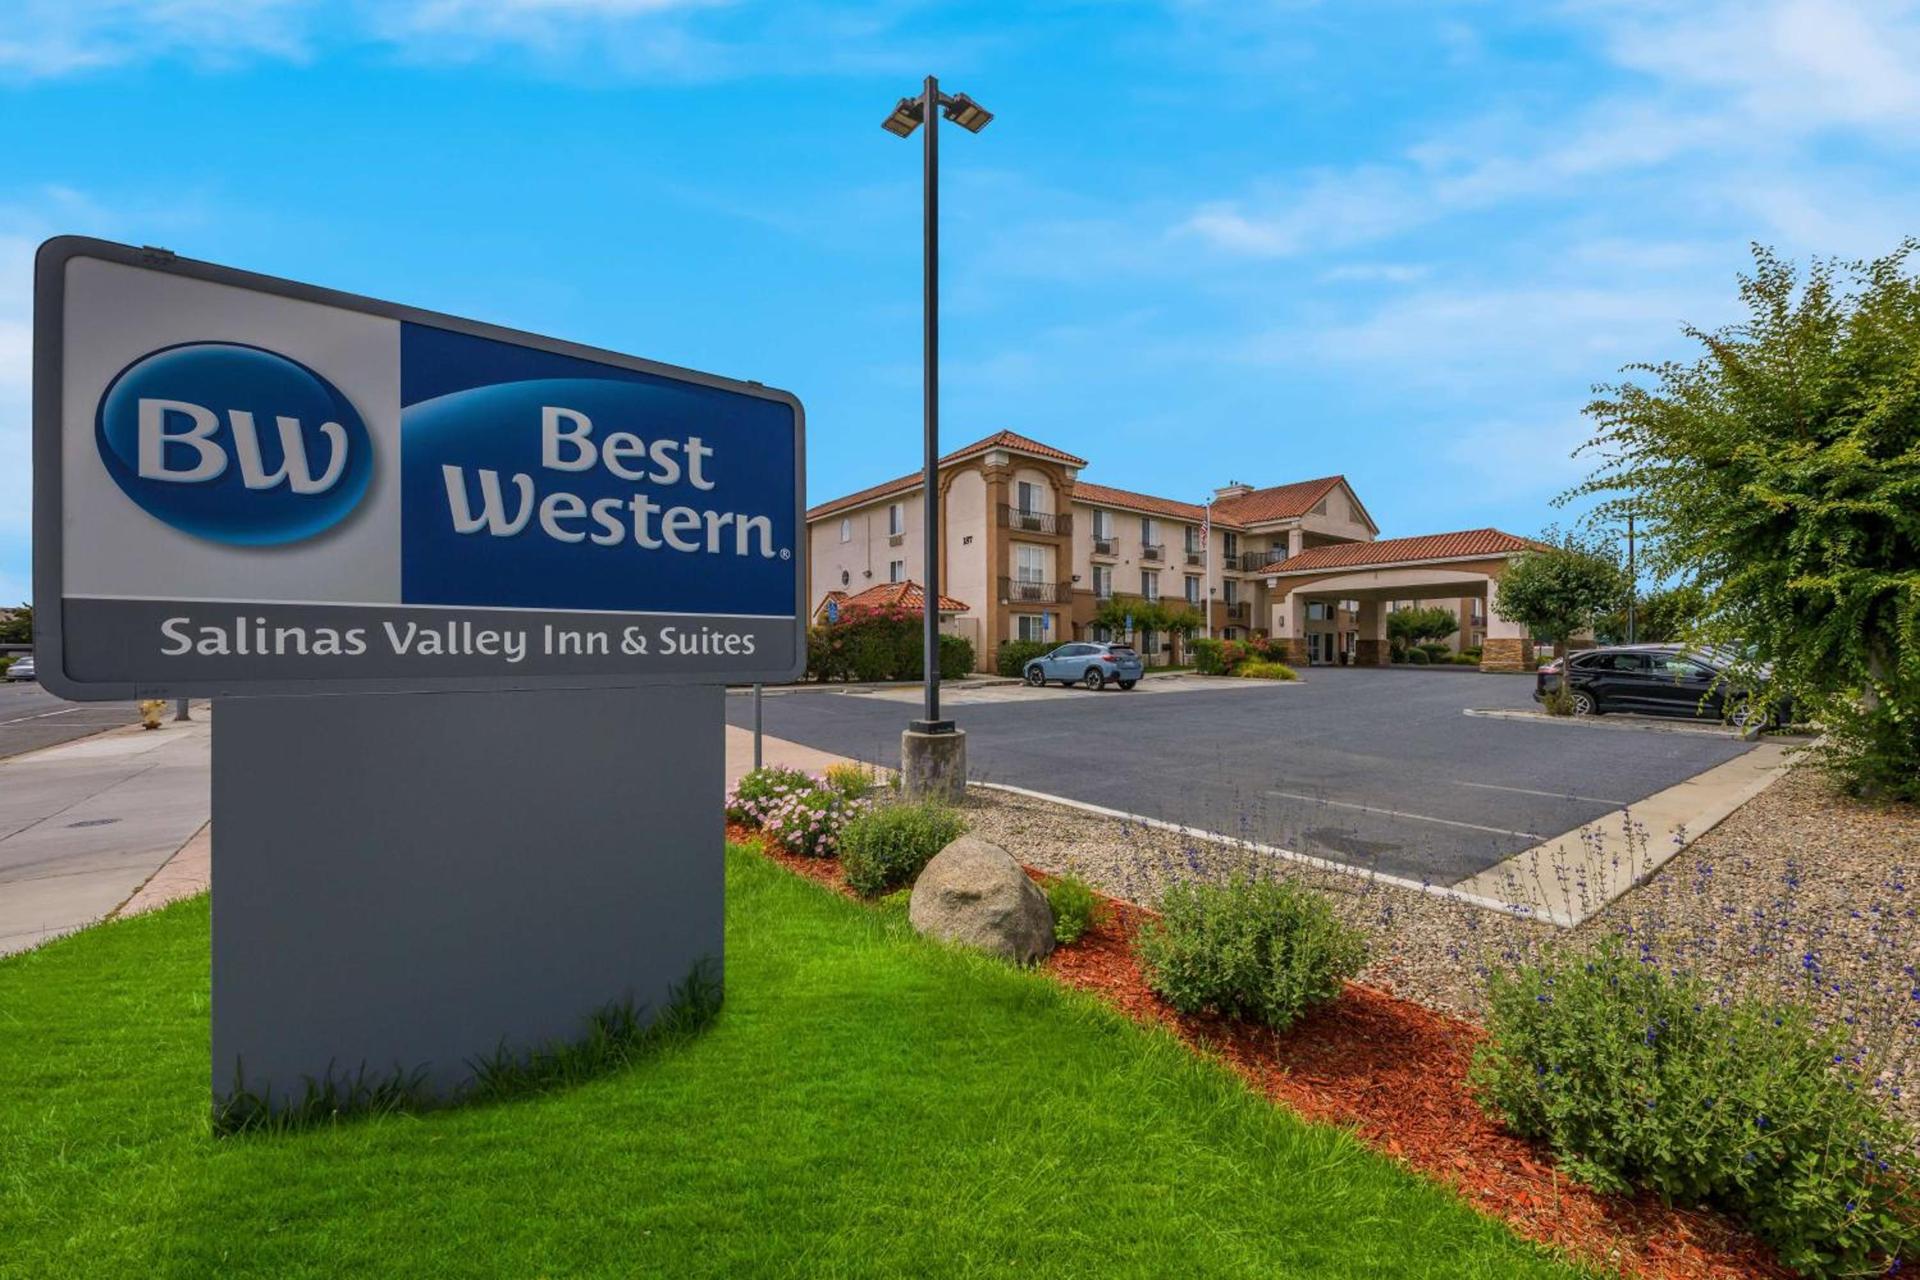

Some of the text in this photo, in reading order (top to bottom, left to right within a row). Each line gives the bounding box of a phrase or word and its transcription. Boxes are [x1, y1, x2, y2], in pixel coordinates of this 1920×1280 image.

[139, 398, 347, 494] BW
[541, 406, 716, 491] Best
[160, 616, 755, 662] Salinas Valley Inn & Suites
